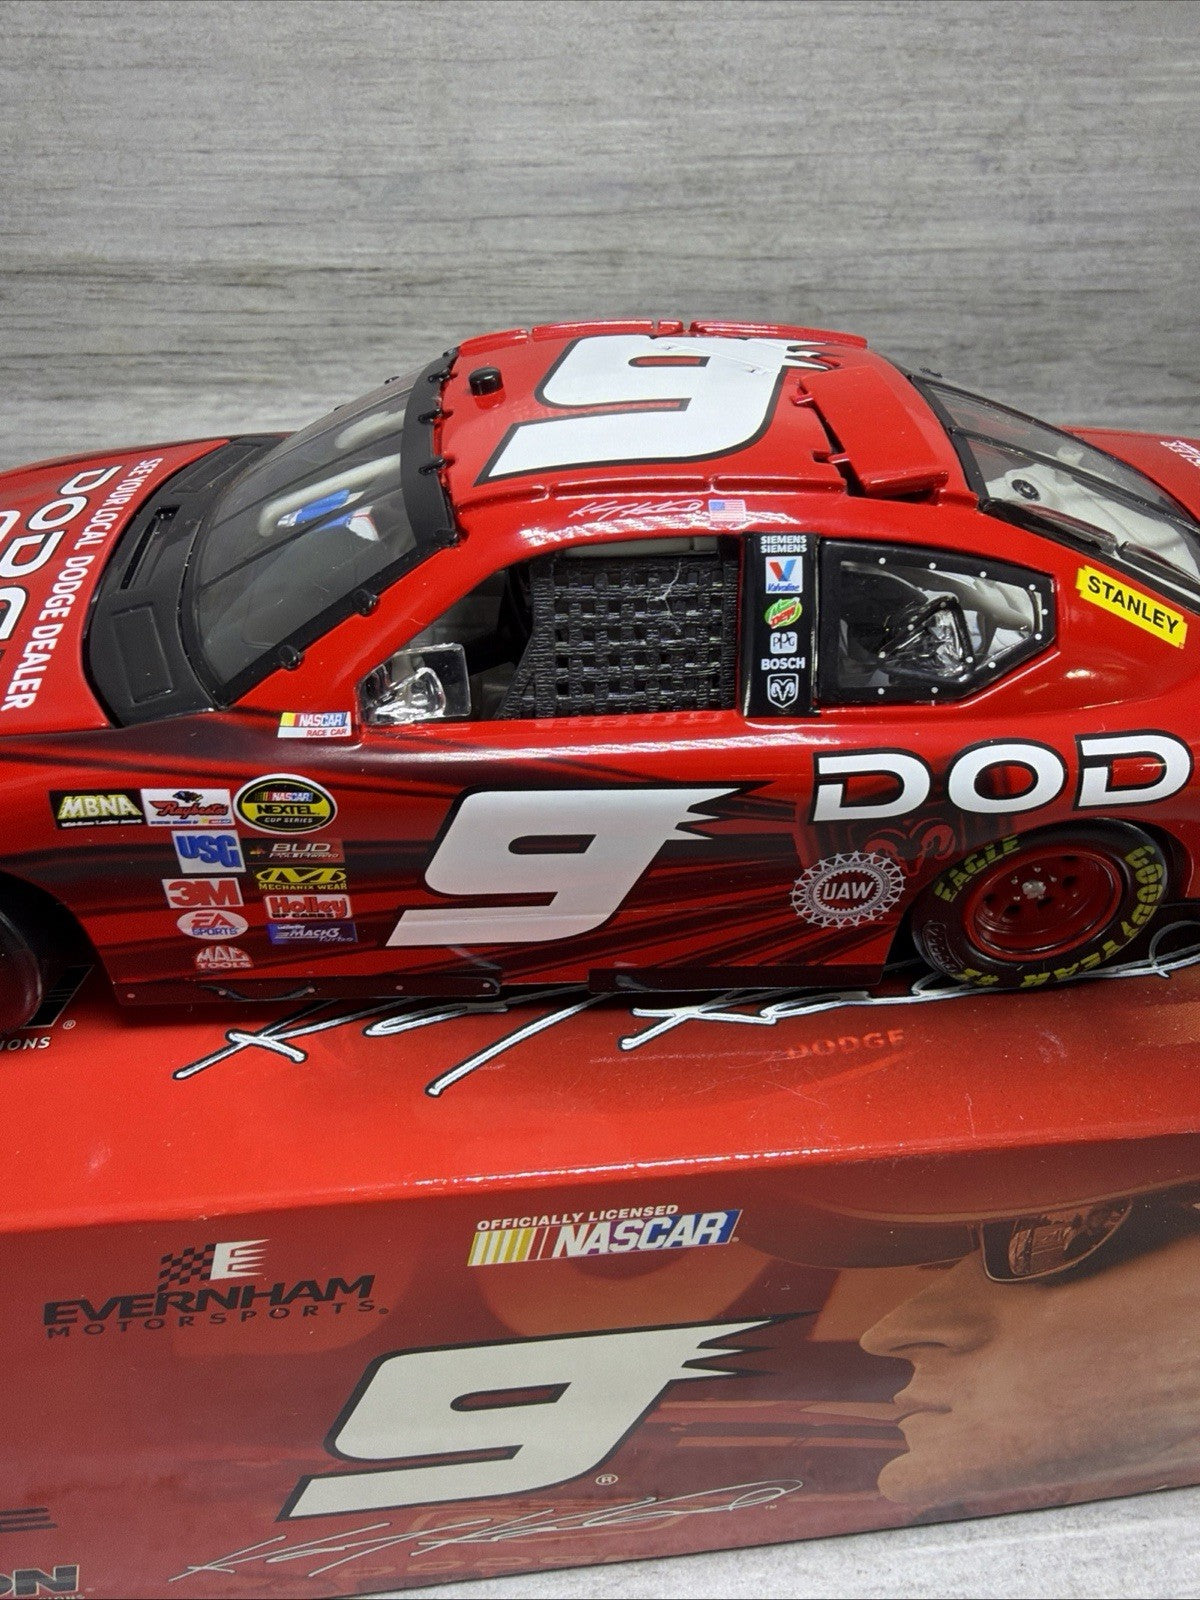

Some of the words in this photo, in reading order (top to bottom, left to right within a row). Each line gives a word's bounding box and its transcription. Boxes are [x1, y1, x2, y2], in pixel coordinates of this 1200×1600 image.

[478, 333, 830, 484] 9
[129, 457, 163, 477] SEE
[102, 475, 149, 507] YOUR
[74, 507, 124, 550] LOCAL
[760, 535, 807, 544] SIEMENS
[760, 544, 808, 553] SIEMENS
[39, 555, 95, 621] DODGE
[767, 583, 800, 592] Valvoline
[1087, 576, 1179, 634] STANLEY
[1, 622, 64, 711] DEALER
[761, 657, 806, 671] BOSCH
[300, 713, 344, 727] NASCAR
[57, 794, 143, 820] MBNA
[256, 804, 315, 815] NEXTEL
[271, 792, 314, 801] NASCAR
[175, 835, 242, 868] USG
[271, 843, 331, 852] BUD
[384, 785, 755, 948] 9
[933, 834, 1021, 902] EAGLE
[168, 880, 241, 908] 3M
[317, 882, 347, 890] WEAR
[822, 881, 875, 901] UAW
[191, 912, 235, 928] EA
[269, 897, 348, 917] Holley
[1019, 845, 1164, 988] GOODYEAR
[192, 927, 238, 936] SPORTS
[197, 946, 248, 962] MAC
[477, 1212, 584, 1231] OFFICIALLY
[589, 1204, 679, 1222] LICENSED
[552, 1211, 729, 1258] NASCAR
[43, 1274, 376, 1325] EVERNHAM
[46, 1301, 376, 1339] MOTORSPORTS
[282, 1316, 785, 1521] 9
